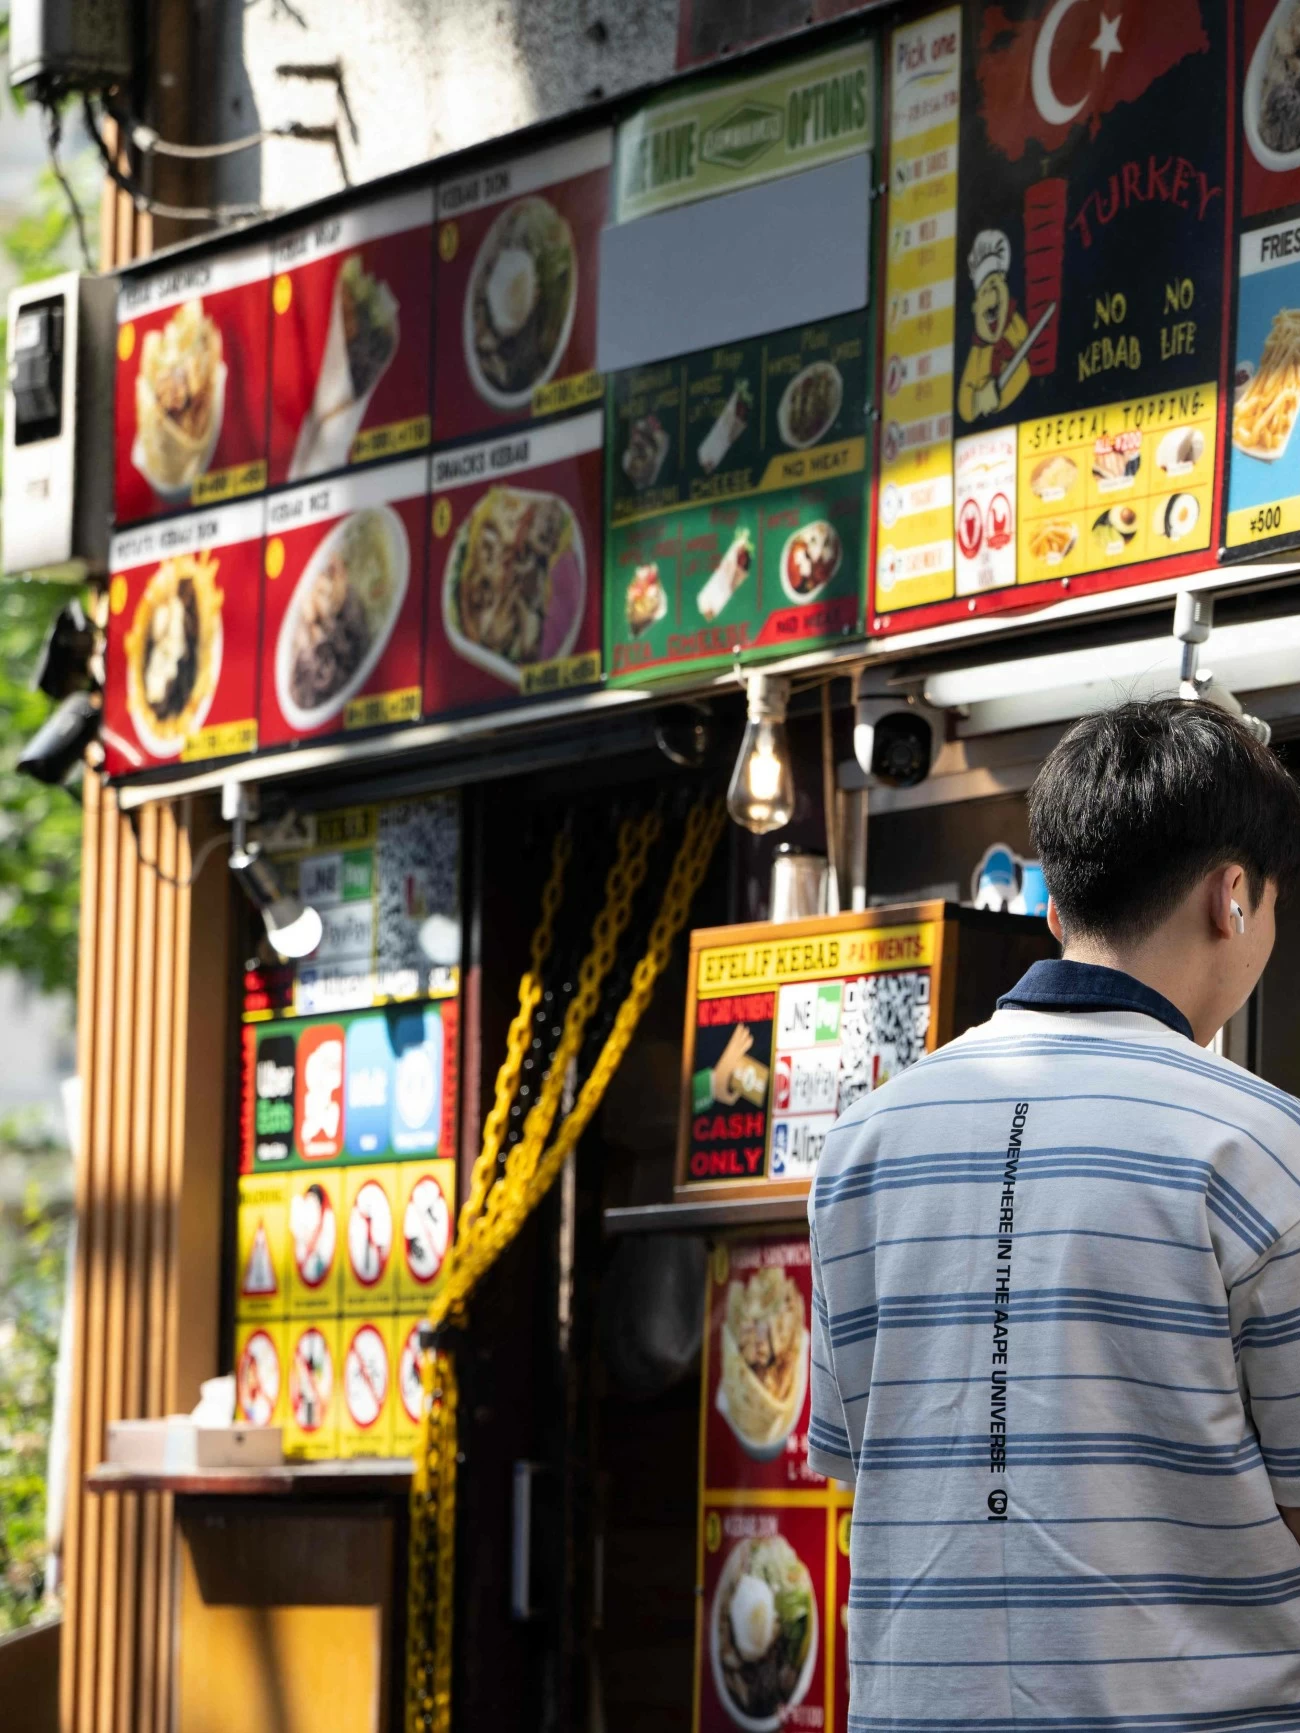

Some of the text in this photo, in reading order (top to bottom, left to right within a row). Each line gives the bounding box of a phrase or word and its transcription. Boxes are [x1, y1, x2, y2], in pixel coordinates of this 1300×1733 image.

[787, 69, 866, 150] OPTIONS
[1069, 155, 1223, 248] TURKEY
[1094, 292, 1127, 328] NO
[1163, 278, 1195, 316] NO
[1078, 336, 1141, 383] KEBAB
[1160, 321, 1197, 361] LIFE
[1250, 506, 1282, 533] ¥500
[776, 941, 840, 974] KEBAB
[692, 1111, 765, 1141] CASH
[690, 1148, 764, 1175] ONLY
[990, 1102, 1029, 1473] SOMEWHERE IN THE AAPE UNIVERSE
